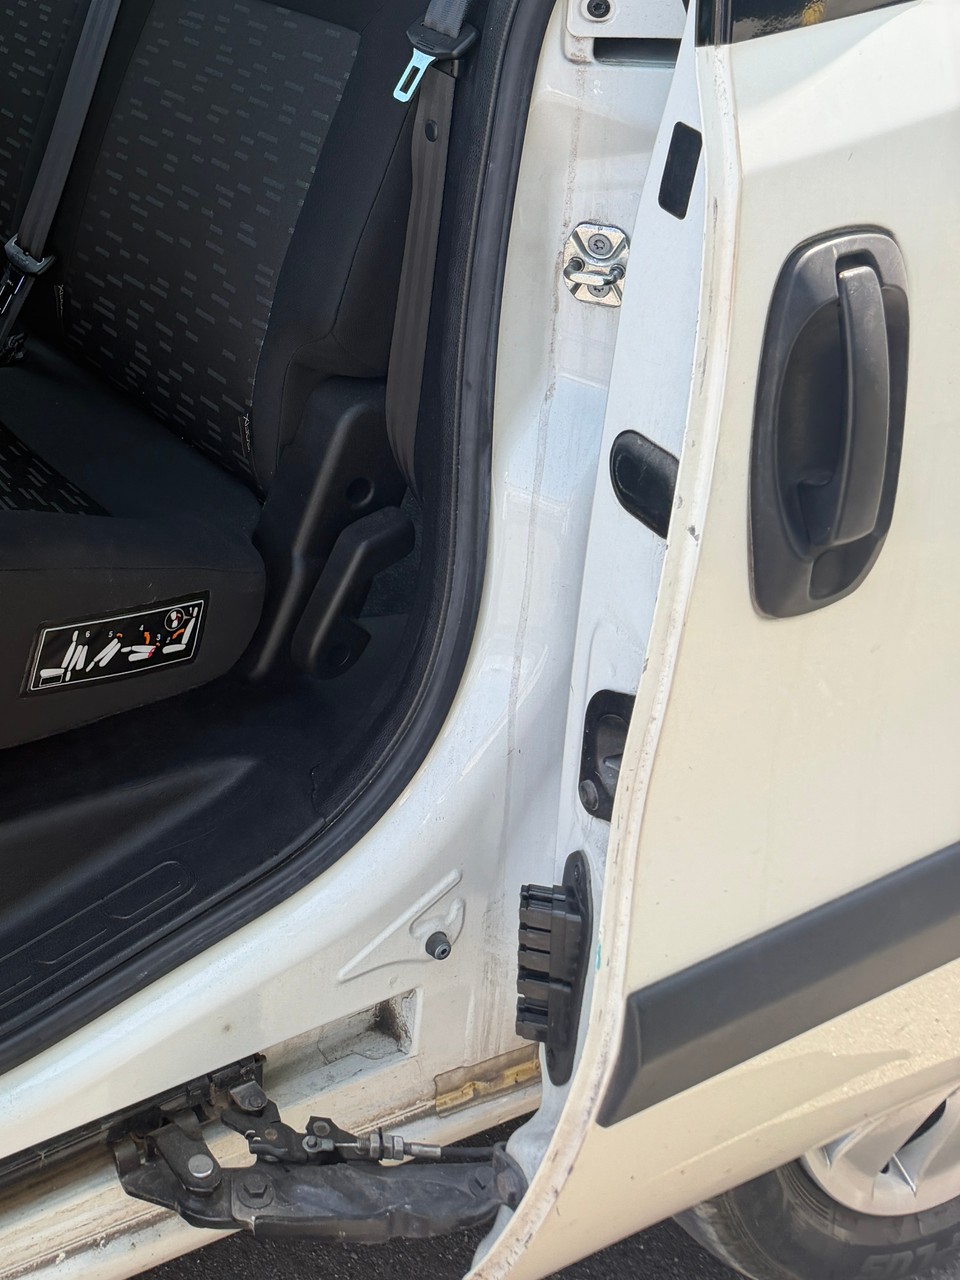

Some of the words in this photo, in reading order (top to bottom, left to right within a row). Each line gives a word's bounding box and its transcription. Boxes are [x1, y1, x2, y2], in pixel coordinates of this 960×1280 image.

[85, 630, 91, 638] 6
[108, 630, 113, 638] 5
[156, 633, 161, 641] 3
